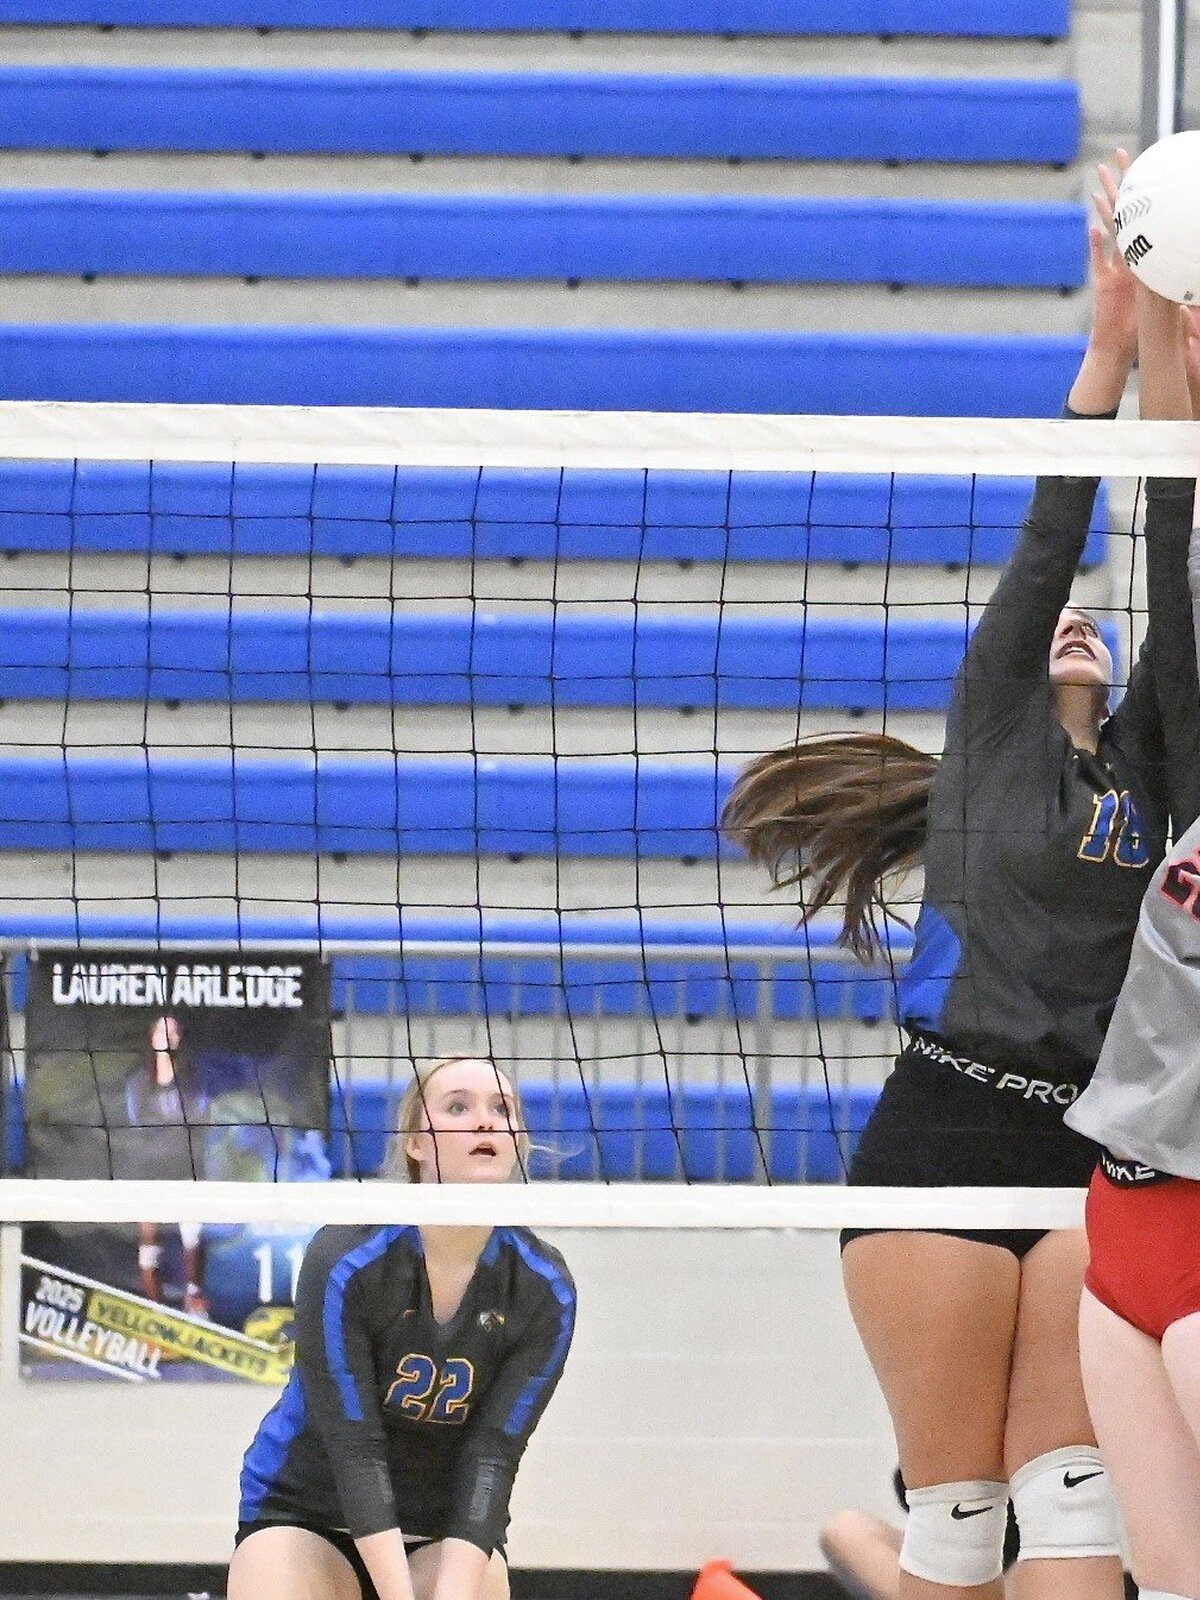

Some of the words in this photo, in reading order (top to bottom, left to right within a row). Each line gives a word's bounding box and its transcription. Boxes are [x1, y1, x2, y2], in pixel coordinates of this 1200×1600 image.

[52, 962, 167, 1007] LAUREN
[172, 964, 304, 1009] ARLEDGE
[912, 1036, 996, 1083] NIKE
[995, 1072, 1079, 1105] PRO
[25, 1302, 161, 1379] VOLLEYBALL
[35, 1275, 86, 1313] 2025
[95, 1301, 268, 1375] YELLOWJACKETS
[382, 1352, 475, 1426] 22
